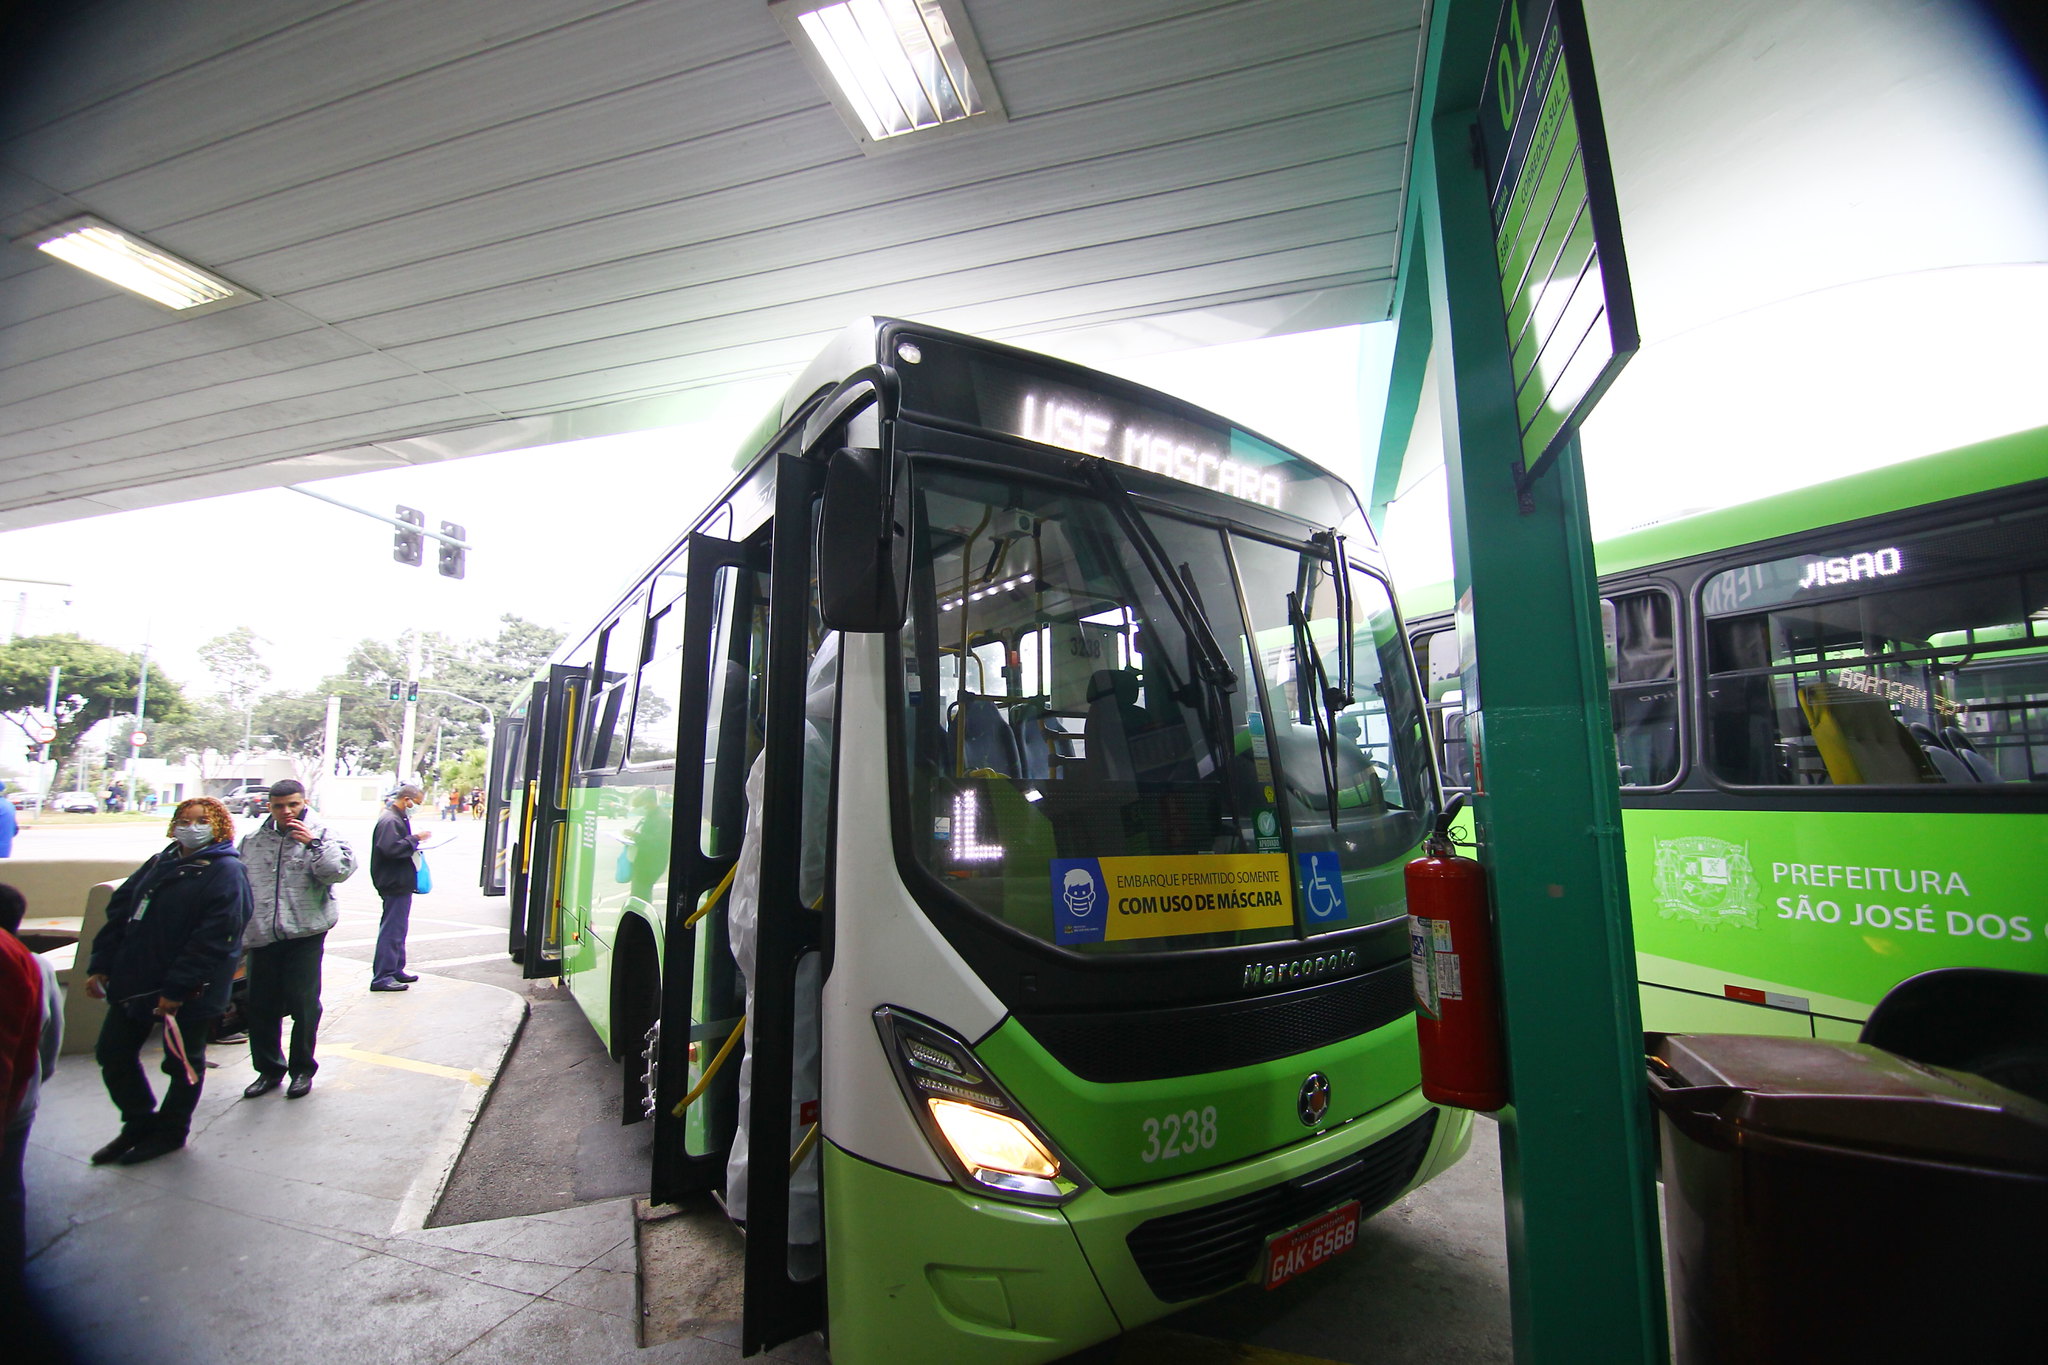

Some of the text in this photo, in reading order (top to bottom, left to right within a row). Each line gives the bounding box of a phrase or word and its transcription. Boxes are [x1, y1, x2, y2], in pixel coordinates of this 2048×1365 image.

[1498, 0, 1529, 131] 01
[1536, 25, 1558, 98] BAIRRO
[1522, 122, 1549, 204] CORREDOR
[1548, 89, 1562, 128] SUL
[1500, 233, 1510, 263] 330
[1022, 394, 1281, 510] USE MASCARA
[1117, 870, 1280, 889] EMBARQUE PERMITIDO SOMENTE
[1118, 889, 1283, 916] COM USO DE MÁSCARA
[1772, 862, 1971, 897] PREFEITURA
[1776, 894, 1841, 924] SÃO
[1850, 903, 1936, 934] JOSÉ
[1946, 910, 2033, 942] DOS
[1242, 948, 1358, 988] Marcopolo
[1141, 1105, 1217, 1163] 3238
